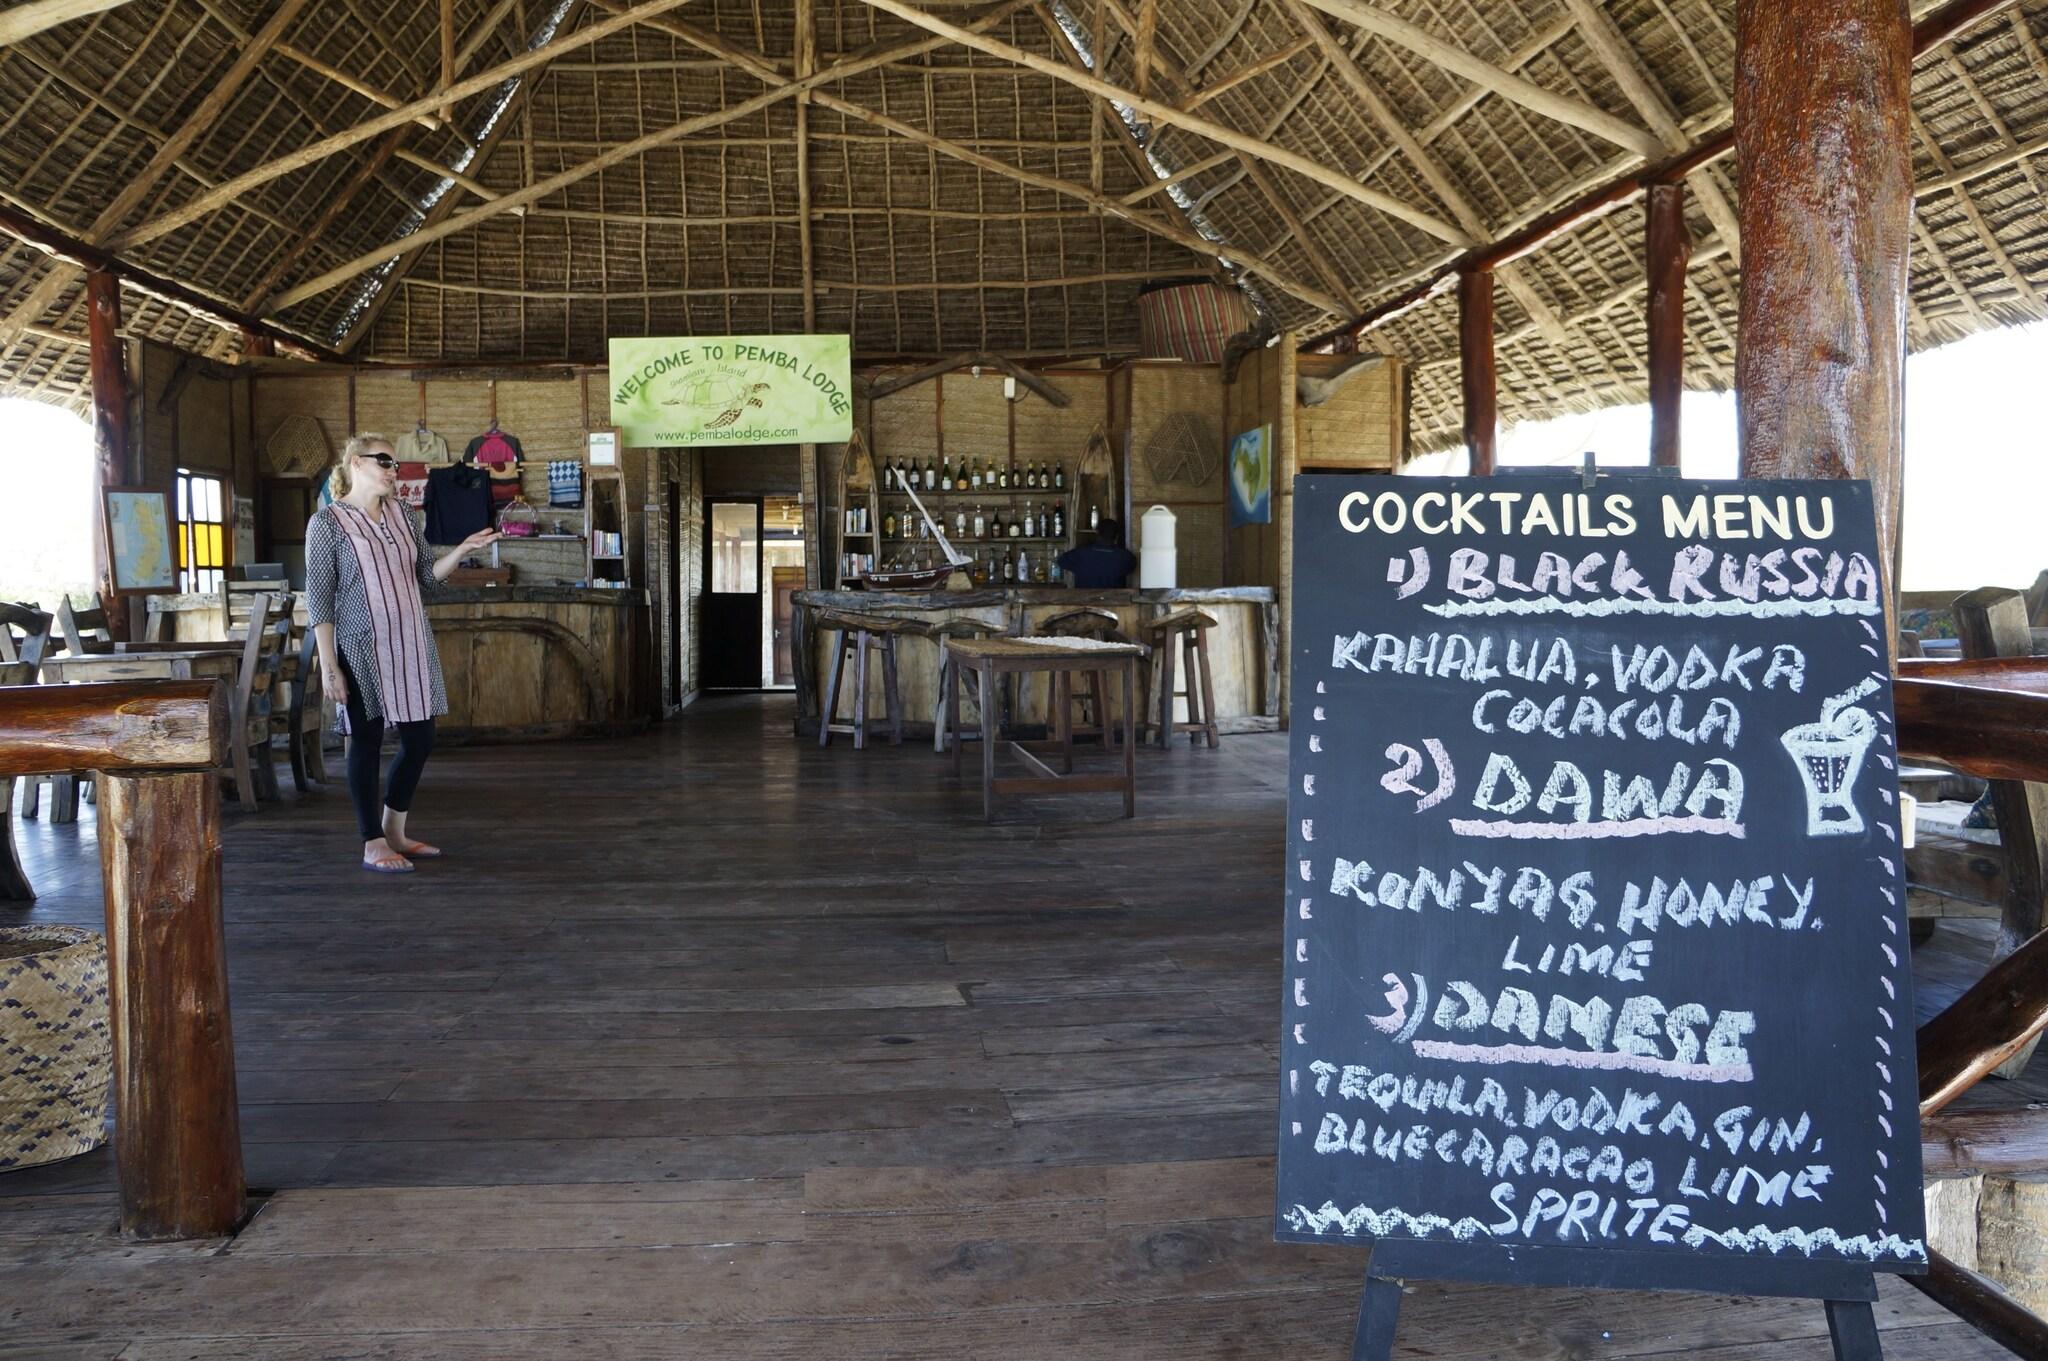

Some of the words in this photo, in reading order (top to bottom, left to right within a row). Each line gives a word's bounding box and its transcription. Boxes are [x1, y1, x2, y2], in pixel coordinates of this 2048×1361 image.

[613, 349, 693, 407] WELCOME
[702, 345, 723, 361] TO
[735, 344, 798, 374] PEMBA
[802, 363, 851, 416] LODGE
[717, 363, 748, 378] Island
[655, 425, 799, 442] www.pembalodge.com
[1338, 491, 1637, 538] COCKTAILS
[1662, 494, 1834, 540] MENU
[1447, 547, 1656, 601] BLACK
[1669, 544, 1879, 604] RUSSIA
[1611, 643, 1806, 693] VODKA
[1473, 752, 1744, 822] DAWA
[1502, 935, 1653, 982] LIME
[1713, 1105, 1822, 1156] GIN,
[1678, 1156, 1833, 1207] LIME
[1490, 1182, 1690, 1243] SPRITE
